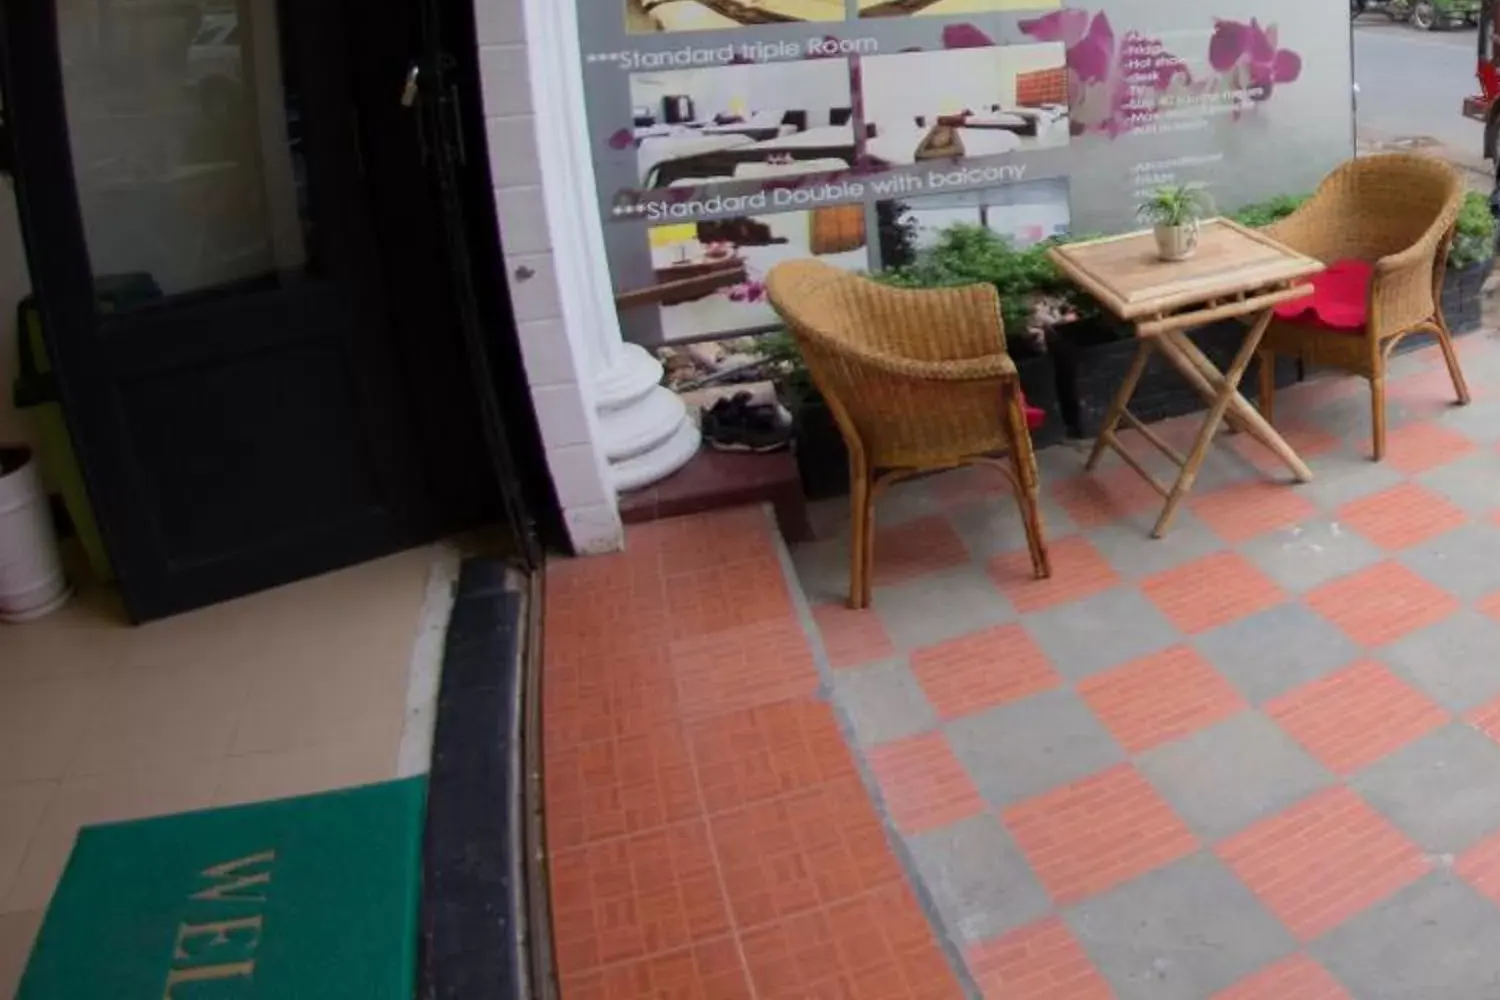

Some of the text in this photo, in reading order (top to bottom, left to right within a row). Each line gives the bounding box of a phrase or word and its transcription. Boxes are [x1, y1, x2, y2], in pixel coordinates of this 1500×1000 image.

[740, 38, 800, 61] triple
[808, 35, 879, 56] Room
[774, 183, 864, 206] Double
[871, 168, 921, 195] with
[163, 848, 276, 1000] WEL
